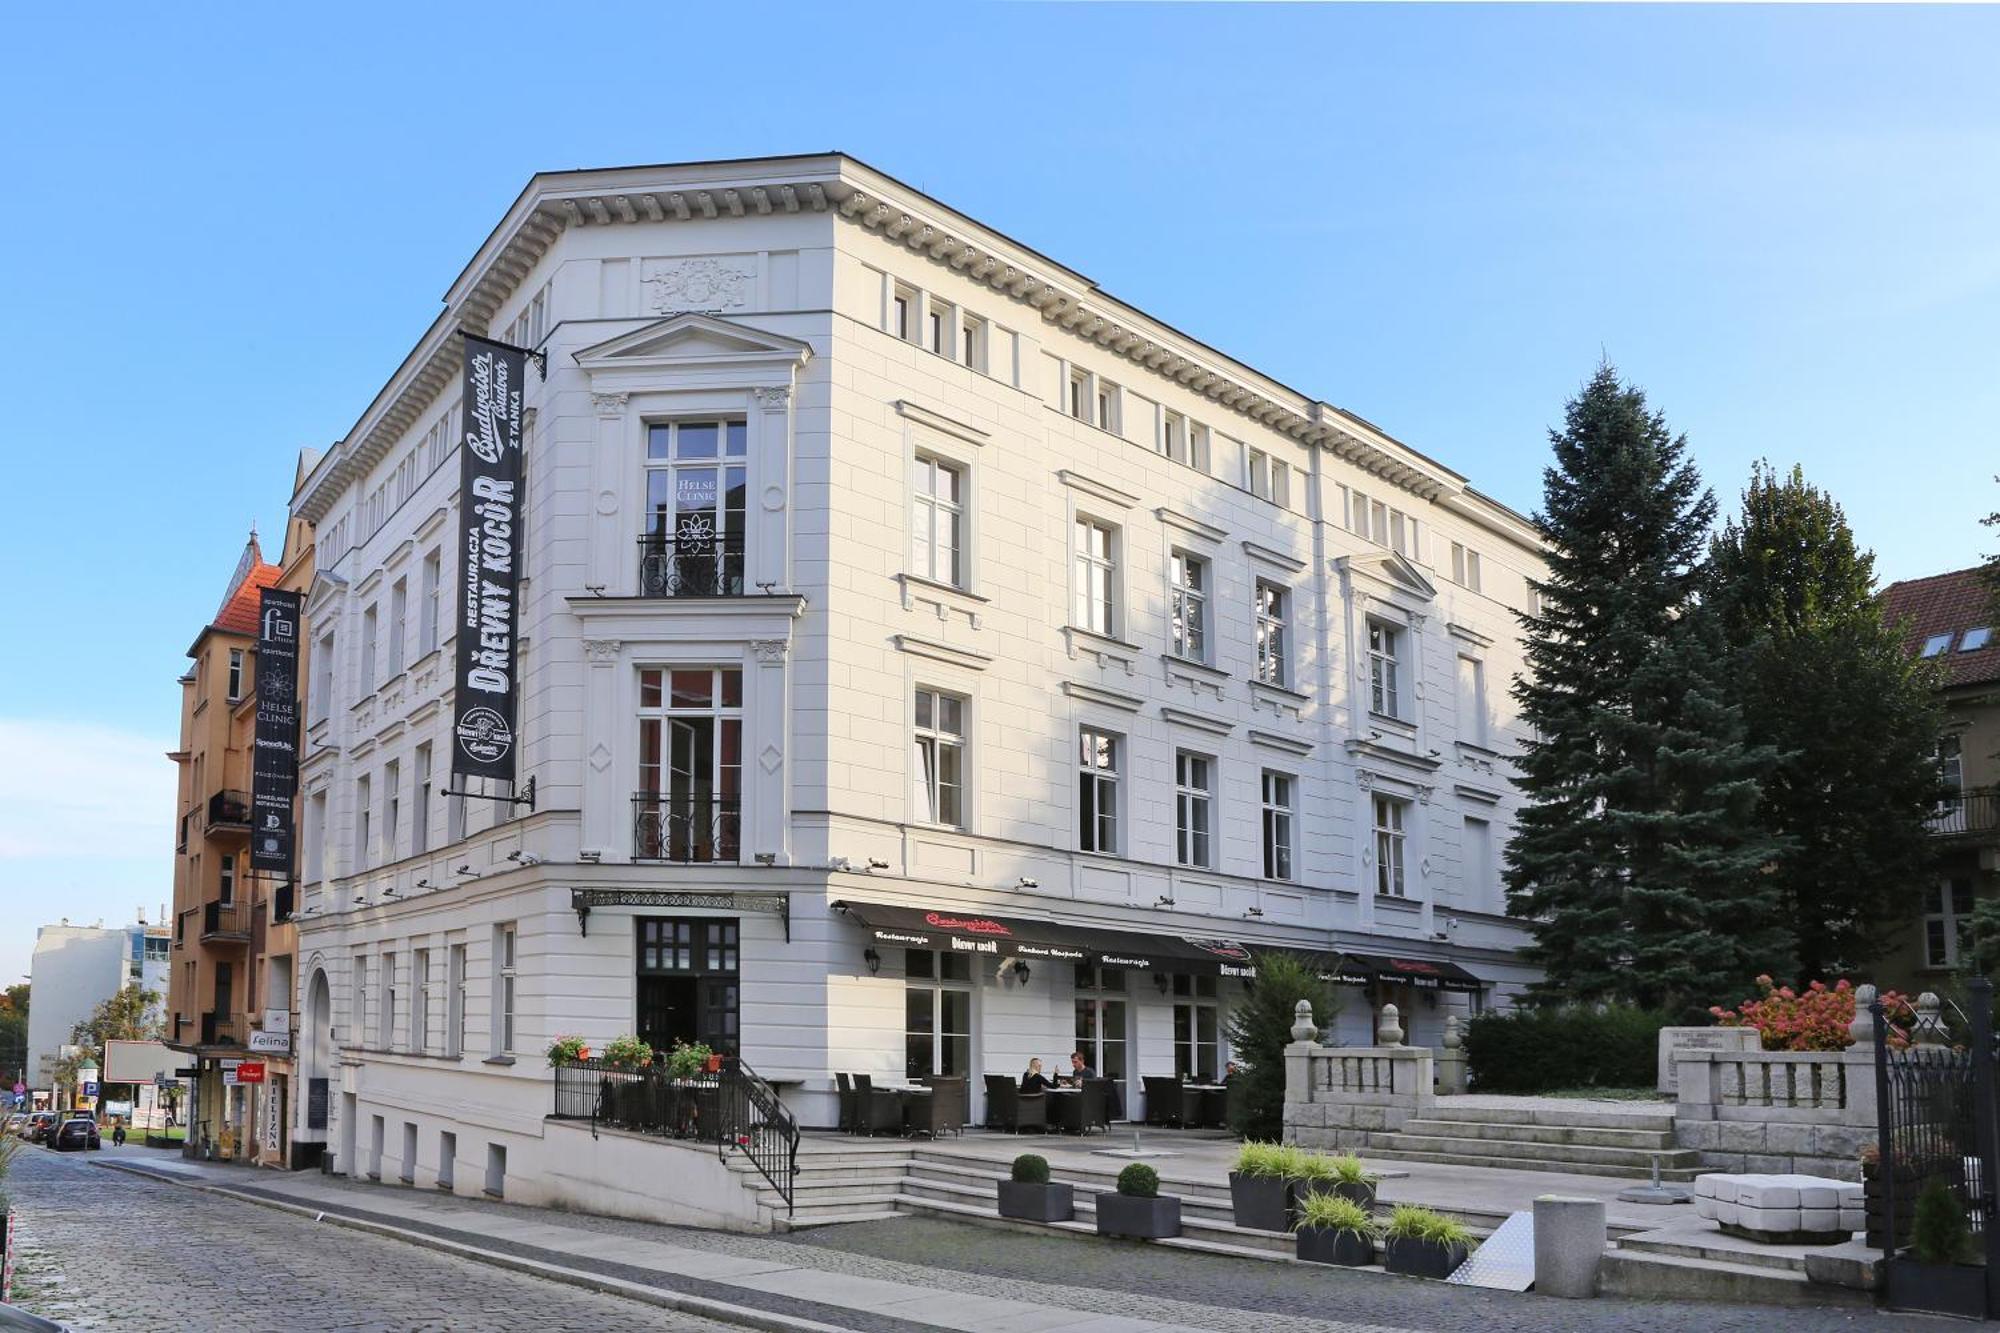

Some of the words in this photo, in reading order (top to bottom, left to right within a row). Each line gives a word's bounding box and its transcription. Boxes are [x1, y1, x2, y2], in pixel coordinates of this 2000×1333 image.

[466, 352, 503, 463] Budweiser
[489, 359, 508, 420] Budvar
[510, 391, 520, 436] TANKA
[510, 438, 519, 448] Z
[467, 527, 479, 628] RESTAURACJA
[268, 1078, 278, 1149] BIELIZNA
